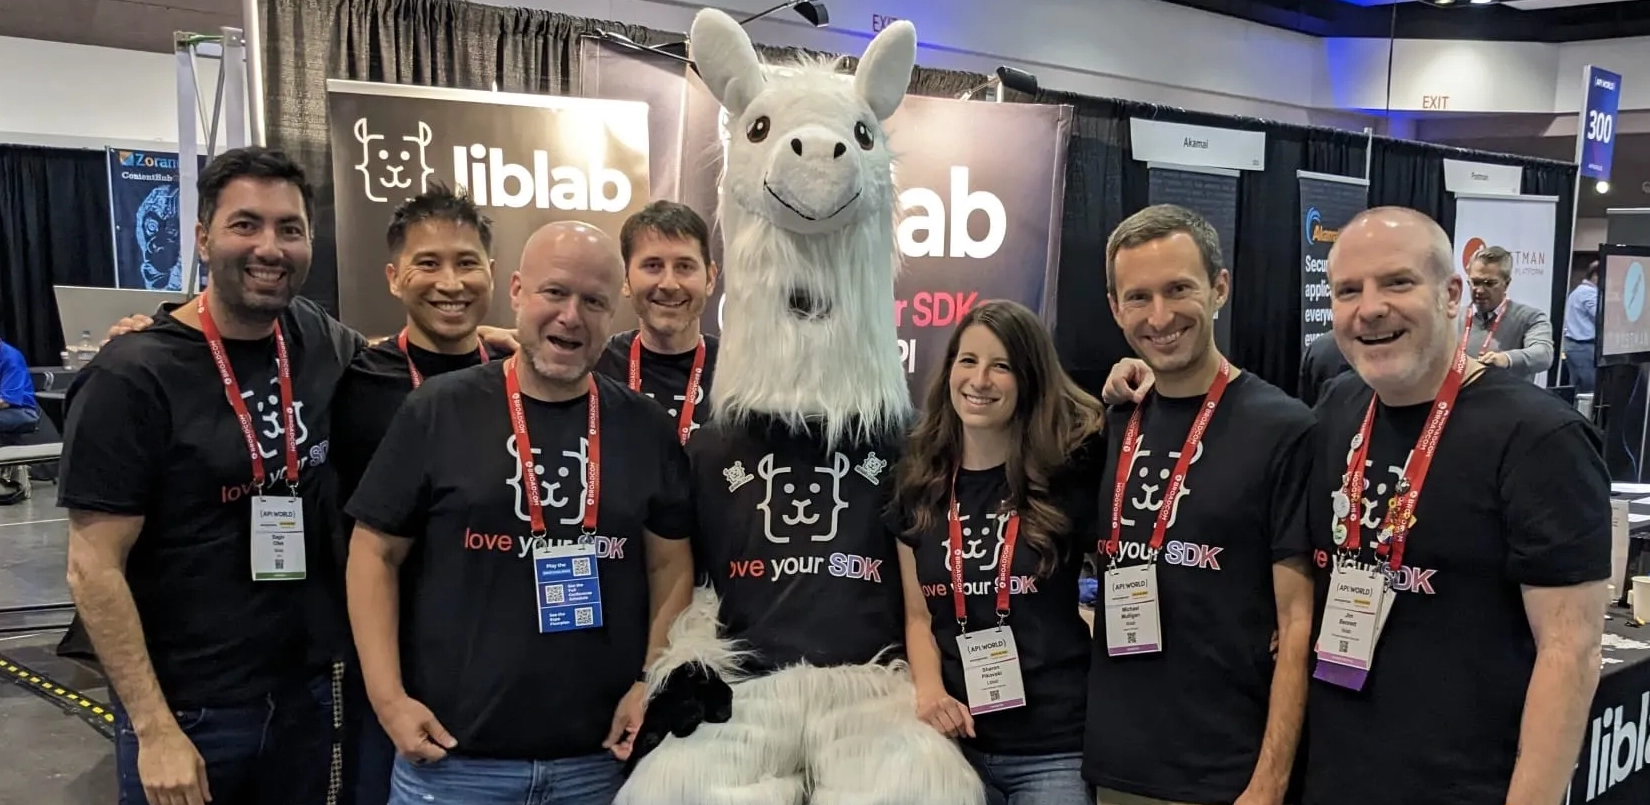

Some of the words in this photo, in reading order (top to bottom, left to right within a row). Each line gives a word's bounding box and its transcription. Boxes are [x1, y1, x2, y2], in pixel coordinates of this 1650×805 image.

[873, 14, 898, 32] EXI
[1422, 95, 1449, 109] EXIT
[1183, 137, 1209, 148] Akamai
[1587, 110, 1612, 144] 300
[135, 153, 178, 168] Zoran
[453, 143, 632, 213] liblab
[893, 165, 1007, 259] ab
[1513, 251, 1545, 265] TMAN
[1305, 280, 1331, 301] applic
[912, 291, 986, 327] SDK
[210, 340, 229, 378] BROADCOM
[897, 339, 916, 373] PI
[239, 414, 255, 453] BROADCOM
[514, 401, 525, 434] BROADCOM
[1192, 407, 1211, 445] BROADCOM
[1421, 409, 1443, 451] BROADCOM
[222, 480, 255, 503] lov
[526, 468, 540, 506] BROADCOM
[588, 462, 596, 497] BROADCOM
[1113, 482, 1123, 521] BROADCOM
[1162, 482, 1178, 520] BROADCOM
[464, 528, 513, 551] love
[1165, 540, 1224, 570] SDK
[771, 556, 824, 582] your
[828, 553, 883, 583] SDK
[1000, 545, 1010, 581] BROADCOM
[922, 584, 947, 598] ove
[1586, 690, 1650, 802] libl
